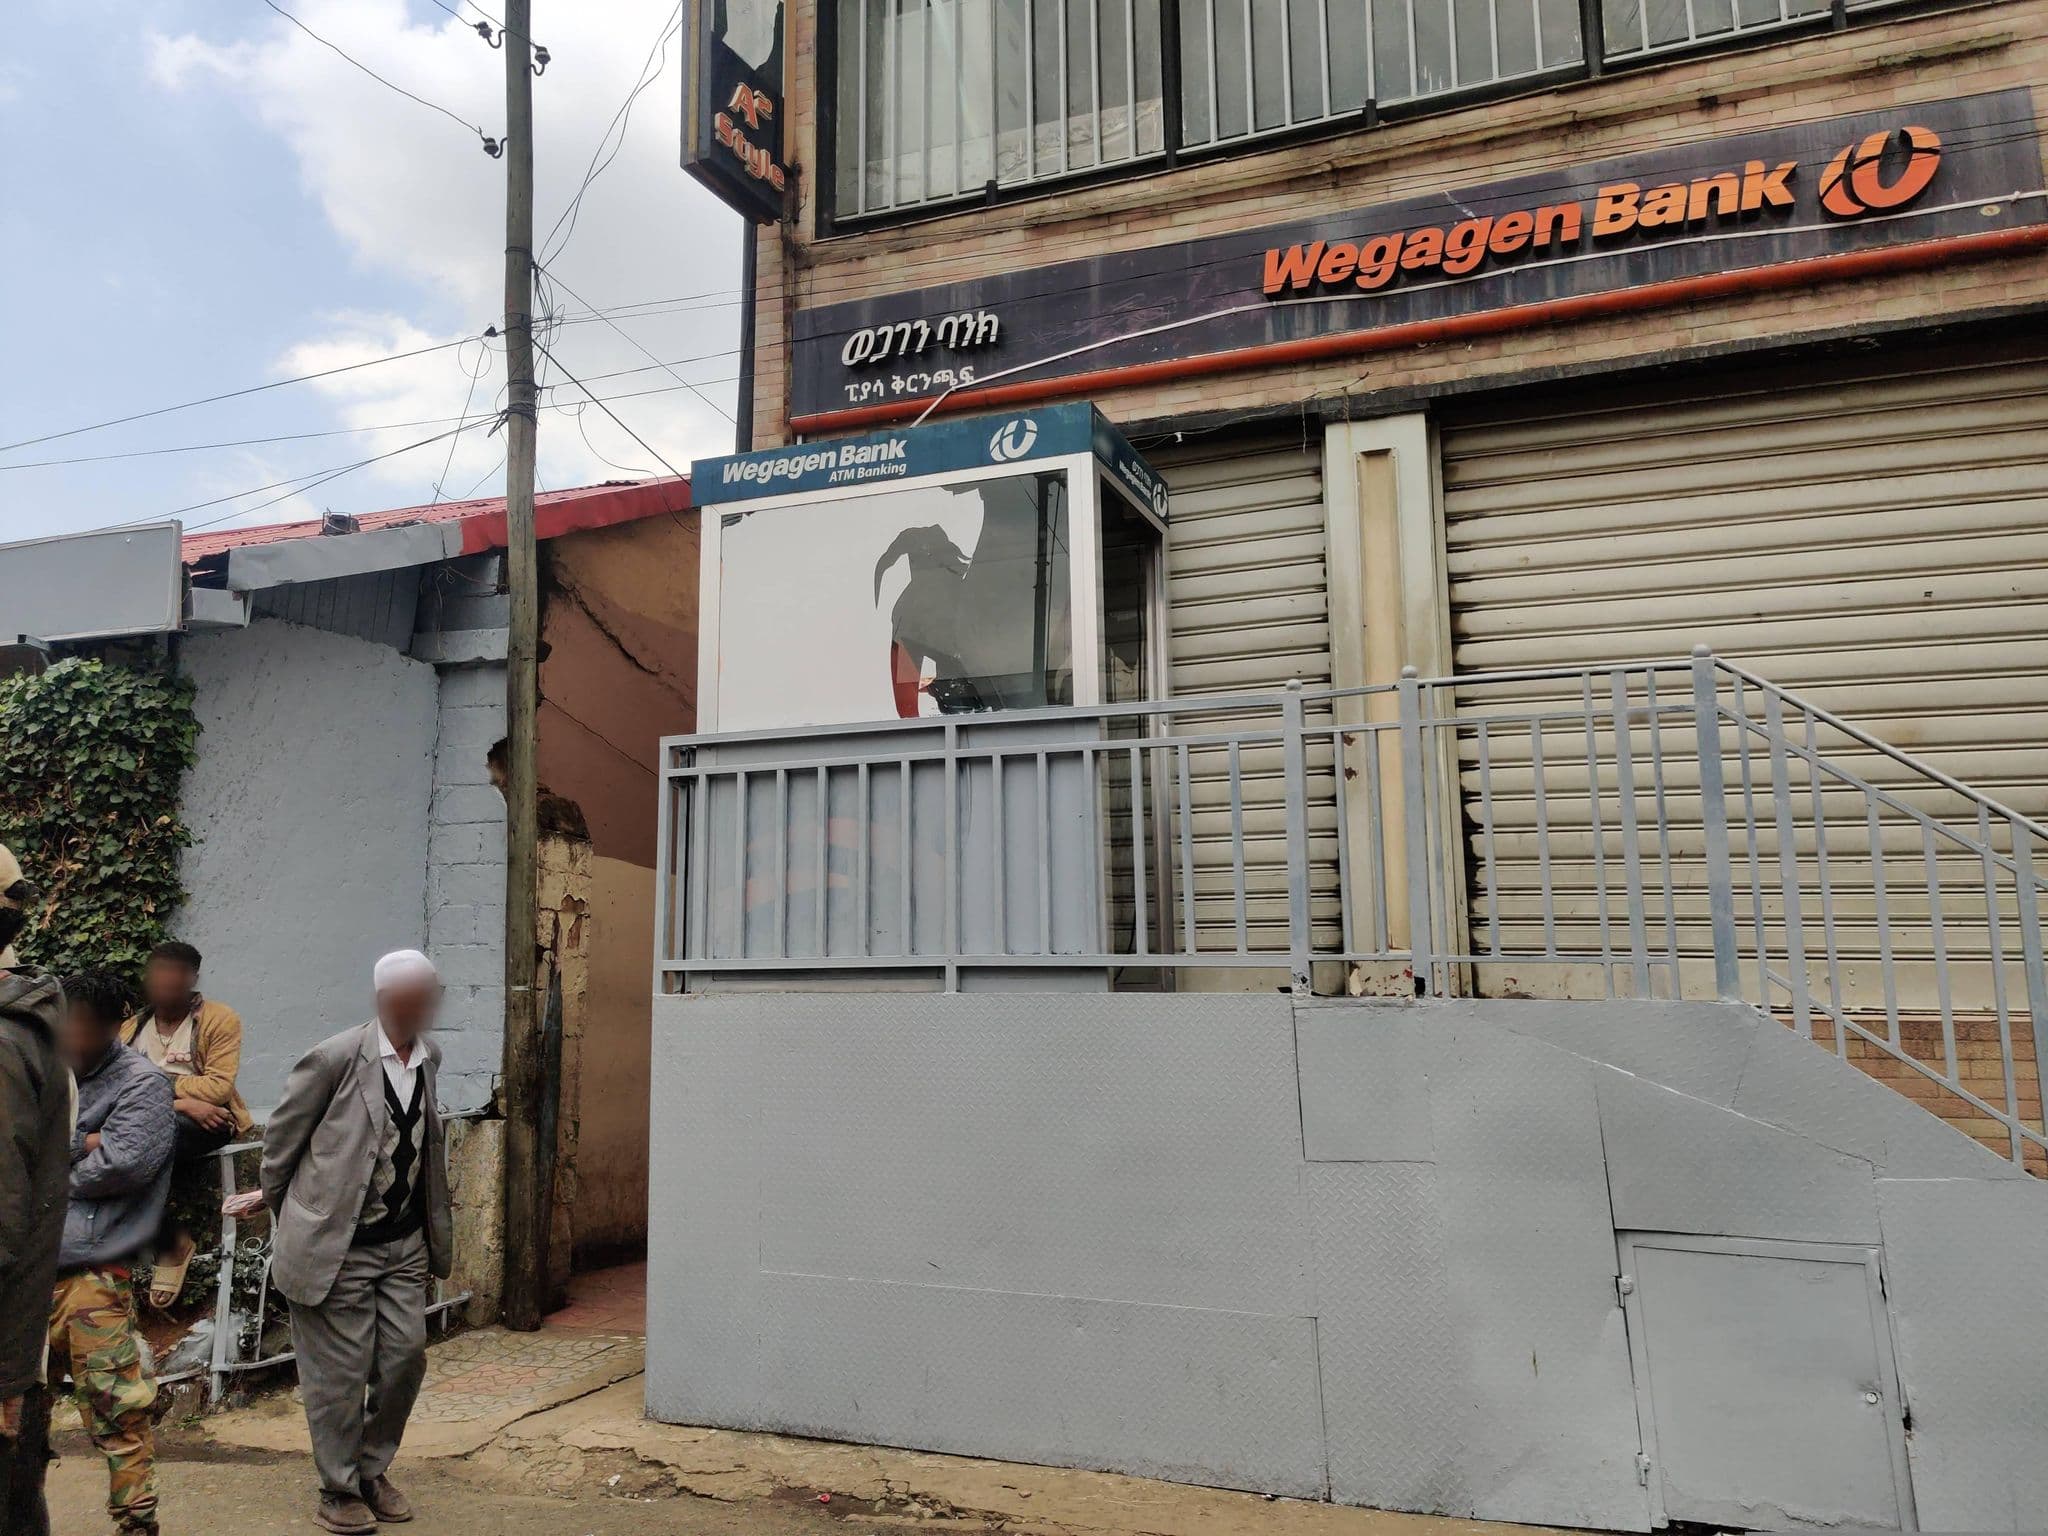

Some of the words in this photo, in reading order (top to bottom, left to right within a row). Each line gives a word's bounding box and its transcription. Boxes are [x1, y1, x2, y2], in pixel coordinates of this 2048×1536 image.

[714, 111, 785, 191] Style
[1262, 202, 1582, 294] Wegagen
[1593, 160, 1797, 237] Bank
[841, 319, 931, 367] ወጋገን
[936, 310, 999, 349] ባንክ
[844, 379, 884, 402] ፒያሳ
[722, 452, 836, 485] Wegagen
[839, 438, 908, 468] Bank
[828, 471, 855, 484] ATM
[857, 462, 907, 480] Banking
